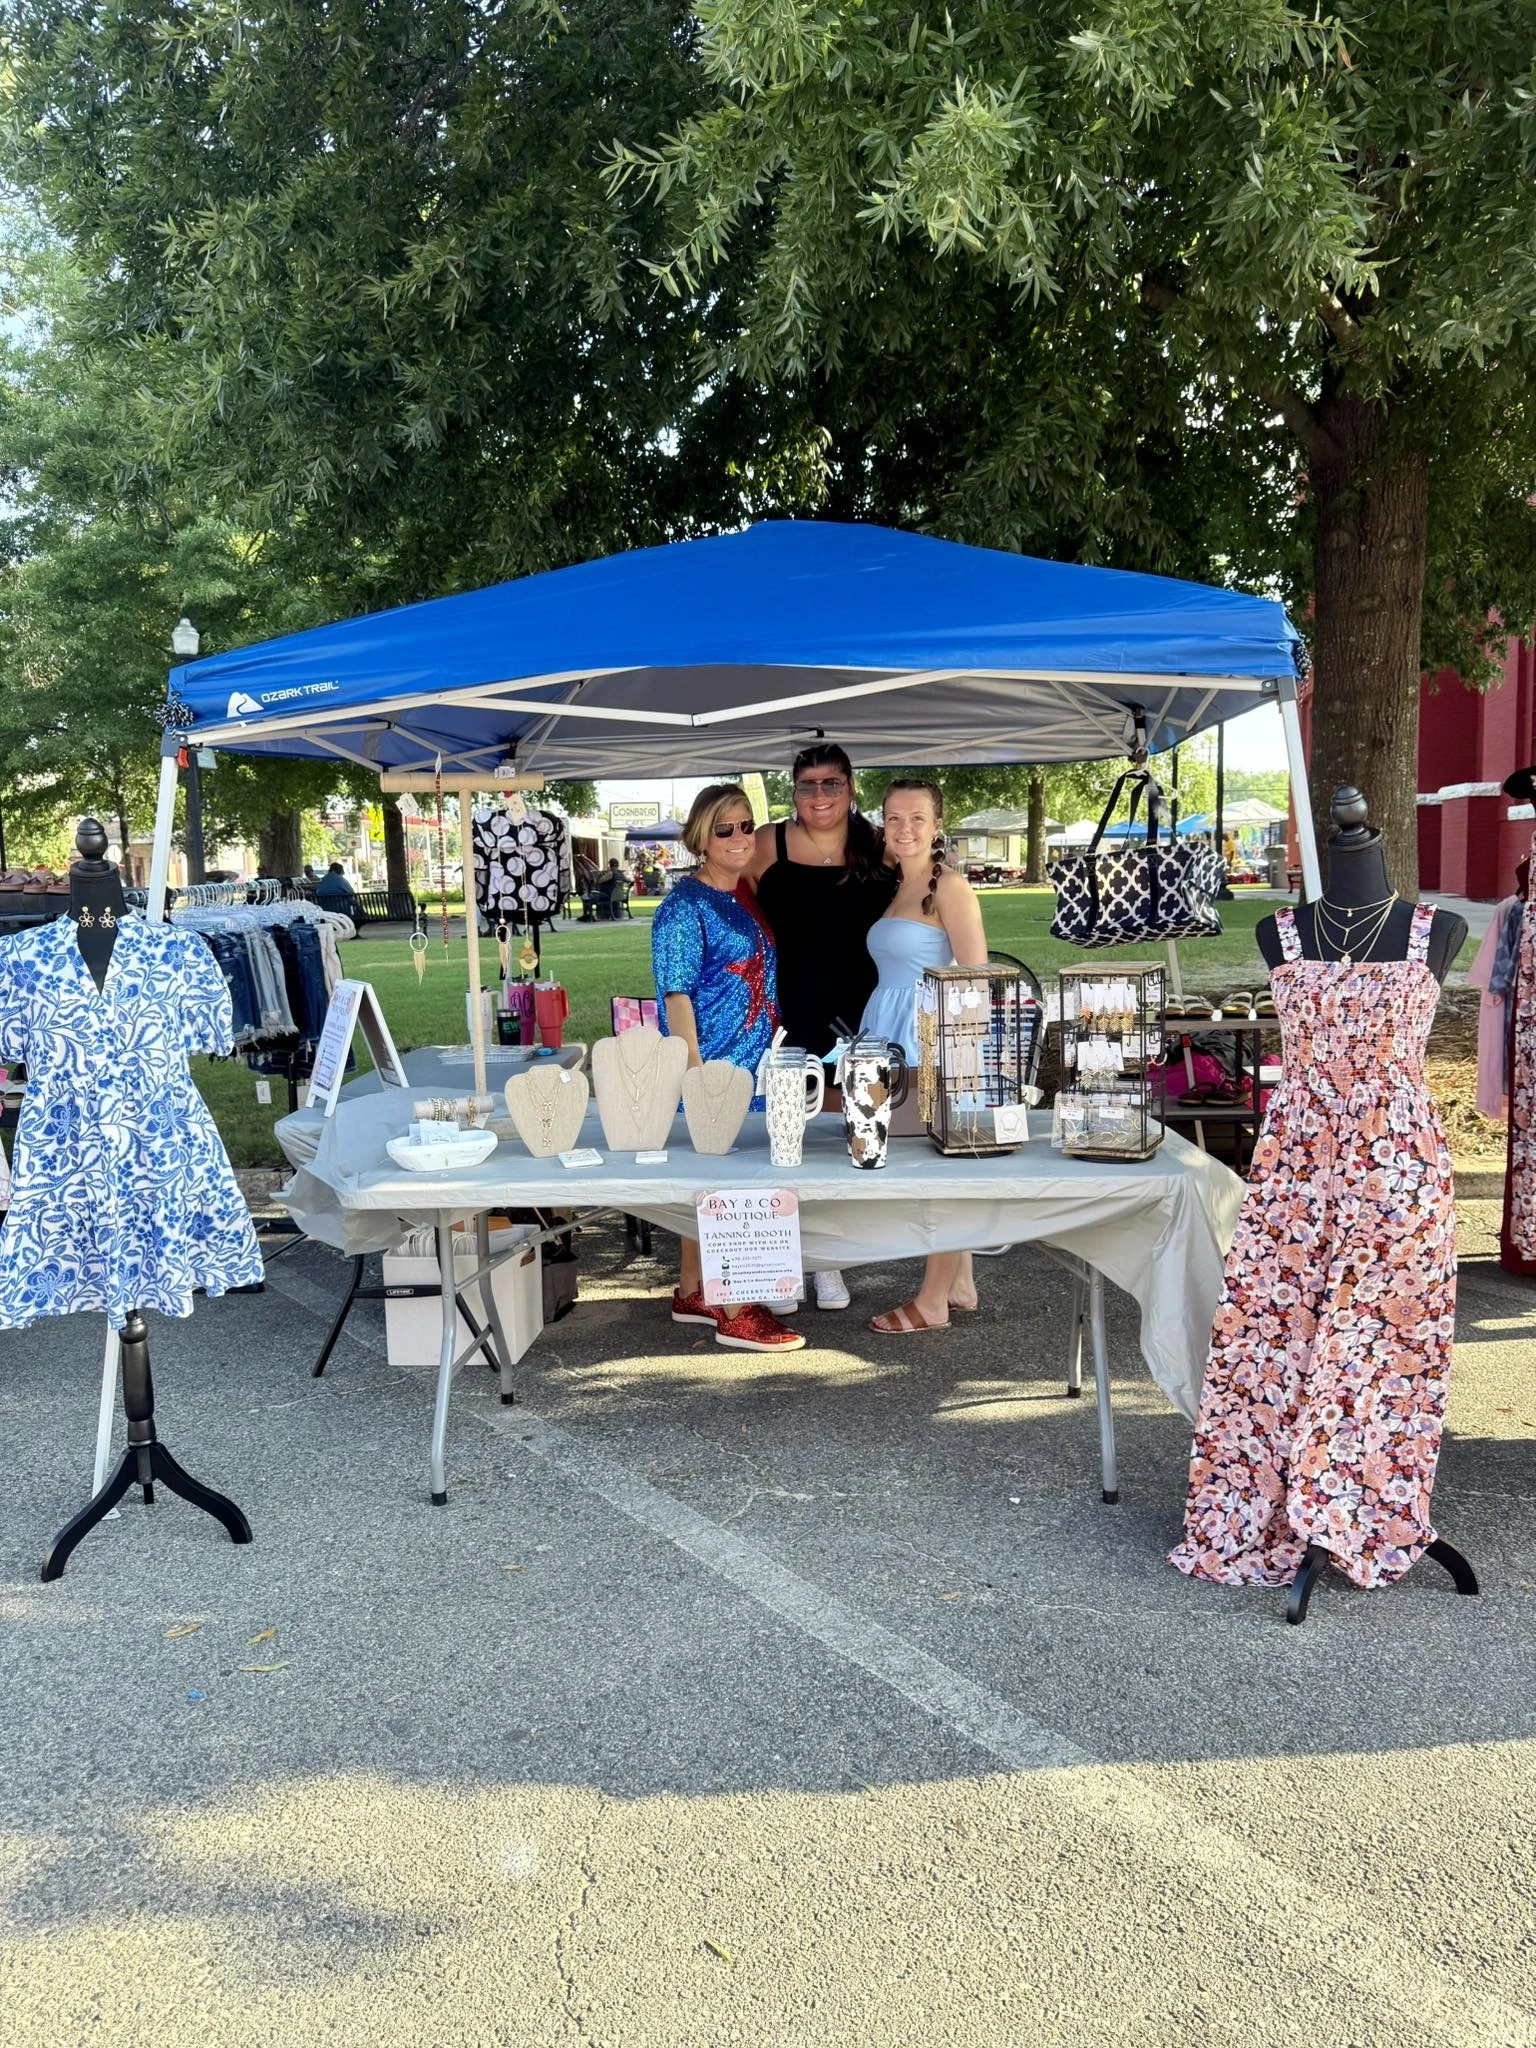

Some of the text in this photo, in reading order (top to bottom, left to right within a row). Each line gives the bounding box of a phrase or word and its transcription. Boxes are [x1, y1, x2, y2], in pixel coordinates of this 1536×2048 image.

[709, 1198, 781, 1209] BAY & CO
[716, 1211, 779, 1221] BOUTIQUE
[742, 1222, 750, 1230] &
[704, 1230, 791, 1240] TANNING BOOTH
